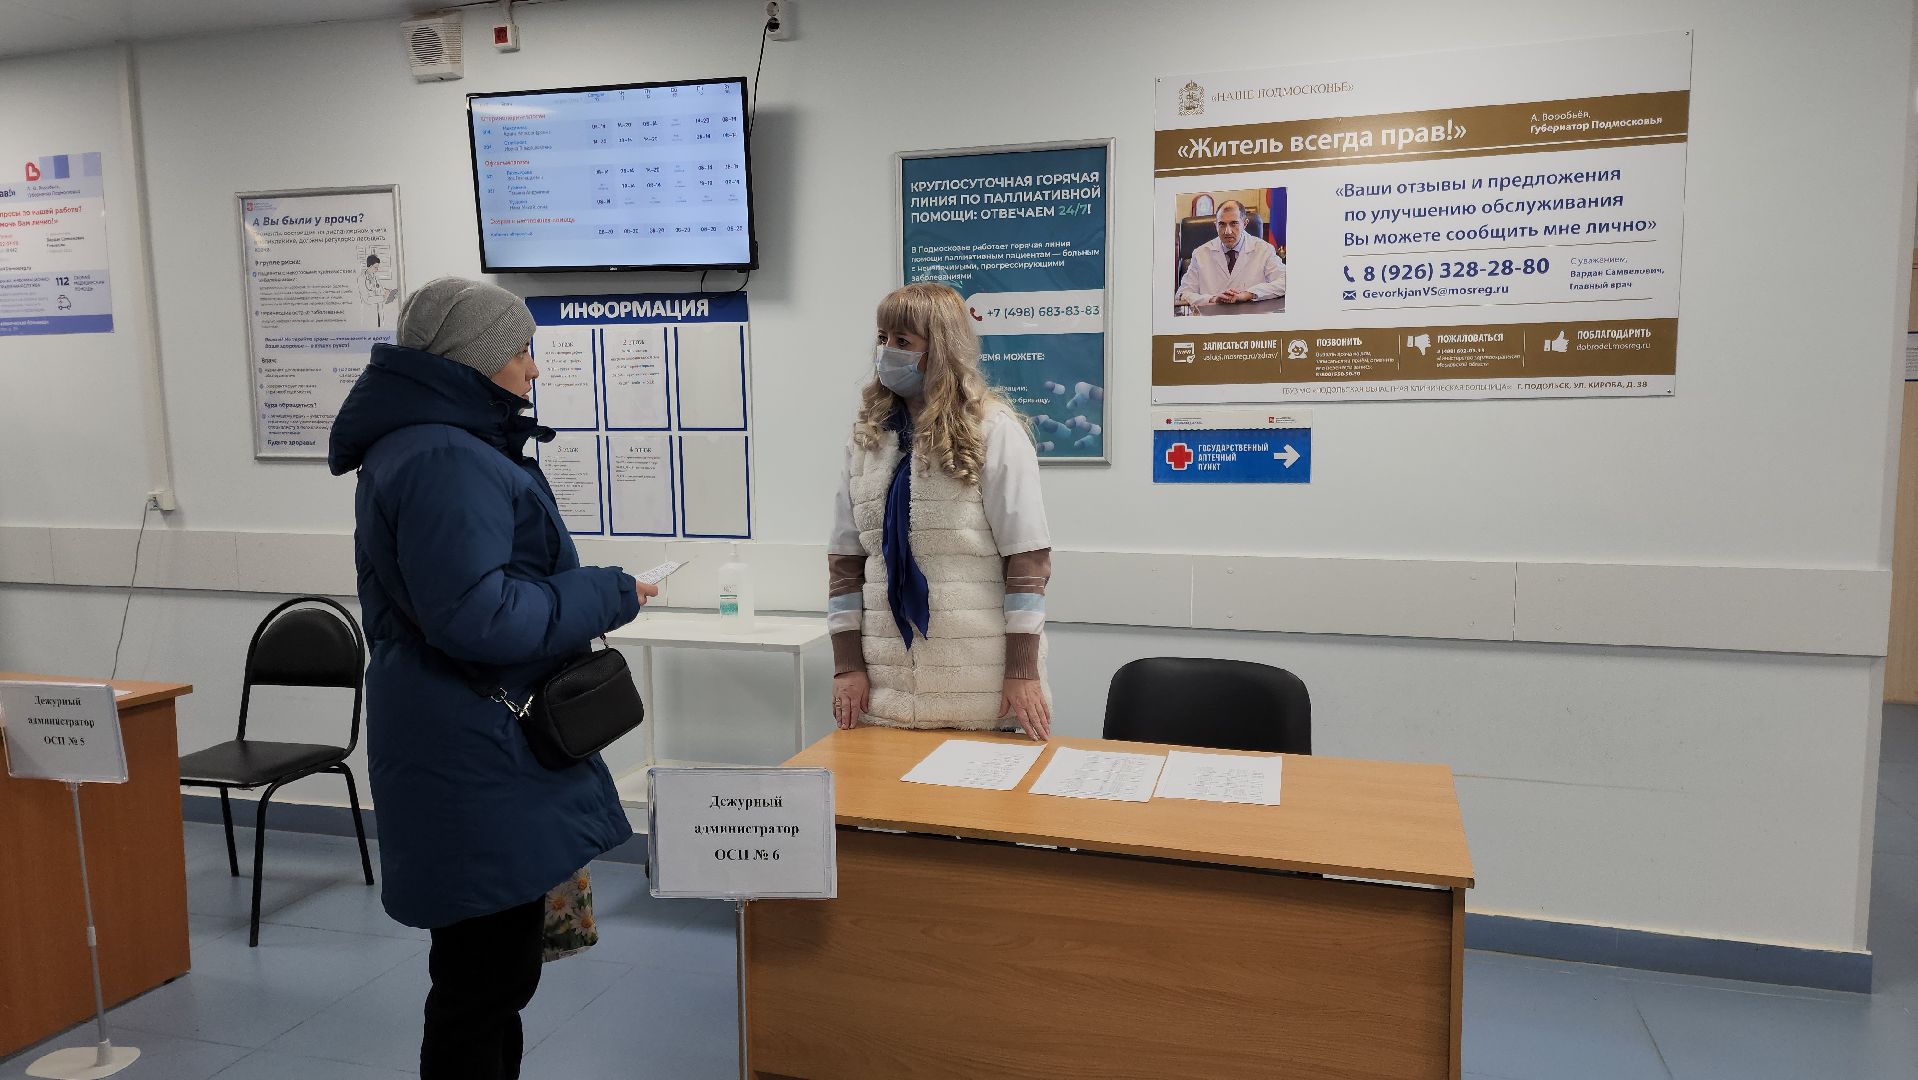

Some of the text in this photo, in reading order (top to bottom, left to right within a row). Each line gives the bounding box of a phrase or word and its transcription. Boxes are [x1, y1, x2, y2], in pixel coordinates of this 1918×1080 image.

[1531, 116, 1663, 135] Губернатор Подмосковья
[1178, 118, 1467, 159] «Житель всегда прав!»
[910, 172, 1100, 192] КРУГЛОСУТОЧНАЯ ГОРЯЧАЯ
[1336, 169, 1622, 198] «Ваши отзывы и предложения
[910, 184, 1101, 208] ЛИНИЯ ПО ПАЛЛИАТИВНОЙ
[911, 203, 1091, 224] ПОМОЩИ: ОТВЕЧАЕМ 24/7!
[1345, 195, 1624, 225] по улучшению обслуживания
[253, 213, 364, 227] А Вы были у врача?
[1345, 220, 1657, 247] Вы можете сообщить мне лично»
[911, 240, 1071, 256] В Подмосковье работает горячая линия
[911, 256, 943, 265] помощи
[944, 253, 1004, 263] паллиативным
[1005, 252, 1051, 262] пациентам
[1062, 248, 1100, 257] больным
[980, 260, 1065, 271] прогрессирующими
[1363, 257, 1550, 283] 8 (926) 328-28-80
[1570, 269, 1603, 279] Вардан
[56, 276, 70, 286] 112
[1569, 281, 1632, 291] Главный врач
[1362, 285, 1509, 300] GevorkjanVS@mosreg.ru
[560, 299, 708, 320] ИНФОРМАЦИЯ
[987, 305, 1100, 319] +7 (498) 683-83-83
[1437, 333, 1504, 344] ПОЖАЛОВАТЬСЯ
[1577, 329, 1651, 341] ПОБЛАГОДАРИТЬ
[1203, 339, 1277, 351] ЗАПИСАТЬСЯ ONLINE
[1316, 337, 1363, 347] ПОЗВОНИТЬ
[1003, 352, 1045, 361] МОЖЕТЕ:
[1524, 382, 1571, 392] ПОДОЛЬСК,
[1588, 382, 1624, 391] КИРОВА,
[1198, 443, 1268, 453] ГОСУДАРСТВЕННЫЙ
[1198, 453, 1236, 462] АПТЕЧНЫЙ
[1198, 463, 1220, 472] ПУНКТ
[34, 695, 82, 707] Дежурный
[28, 717, 95, 728] администратор
[44, 735, 85, 746] ОСП № 5
[709, 795, 783, 811] Дежурный
[694, 824, 800, 838] администратор
[714, 848, 780, 861] ОСП № 6
